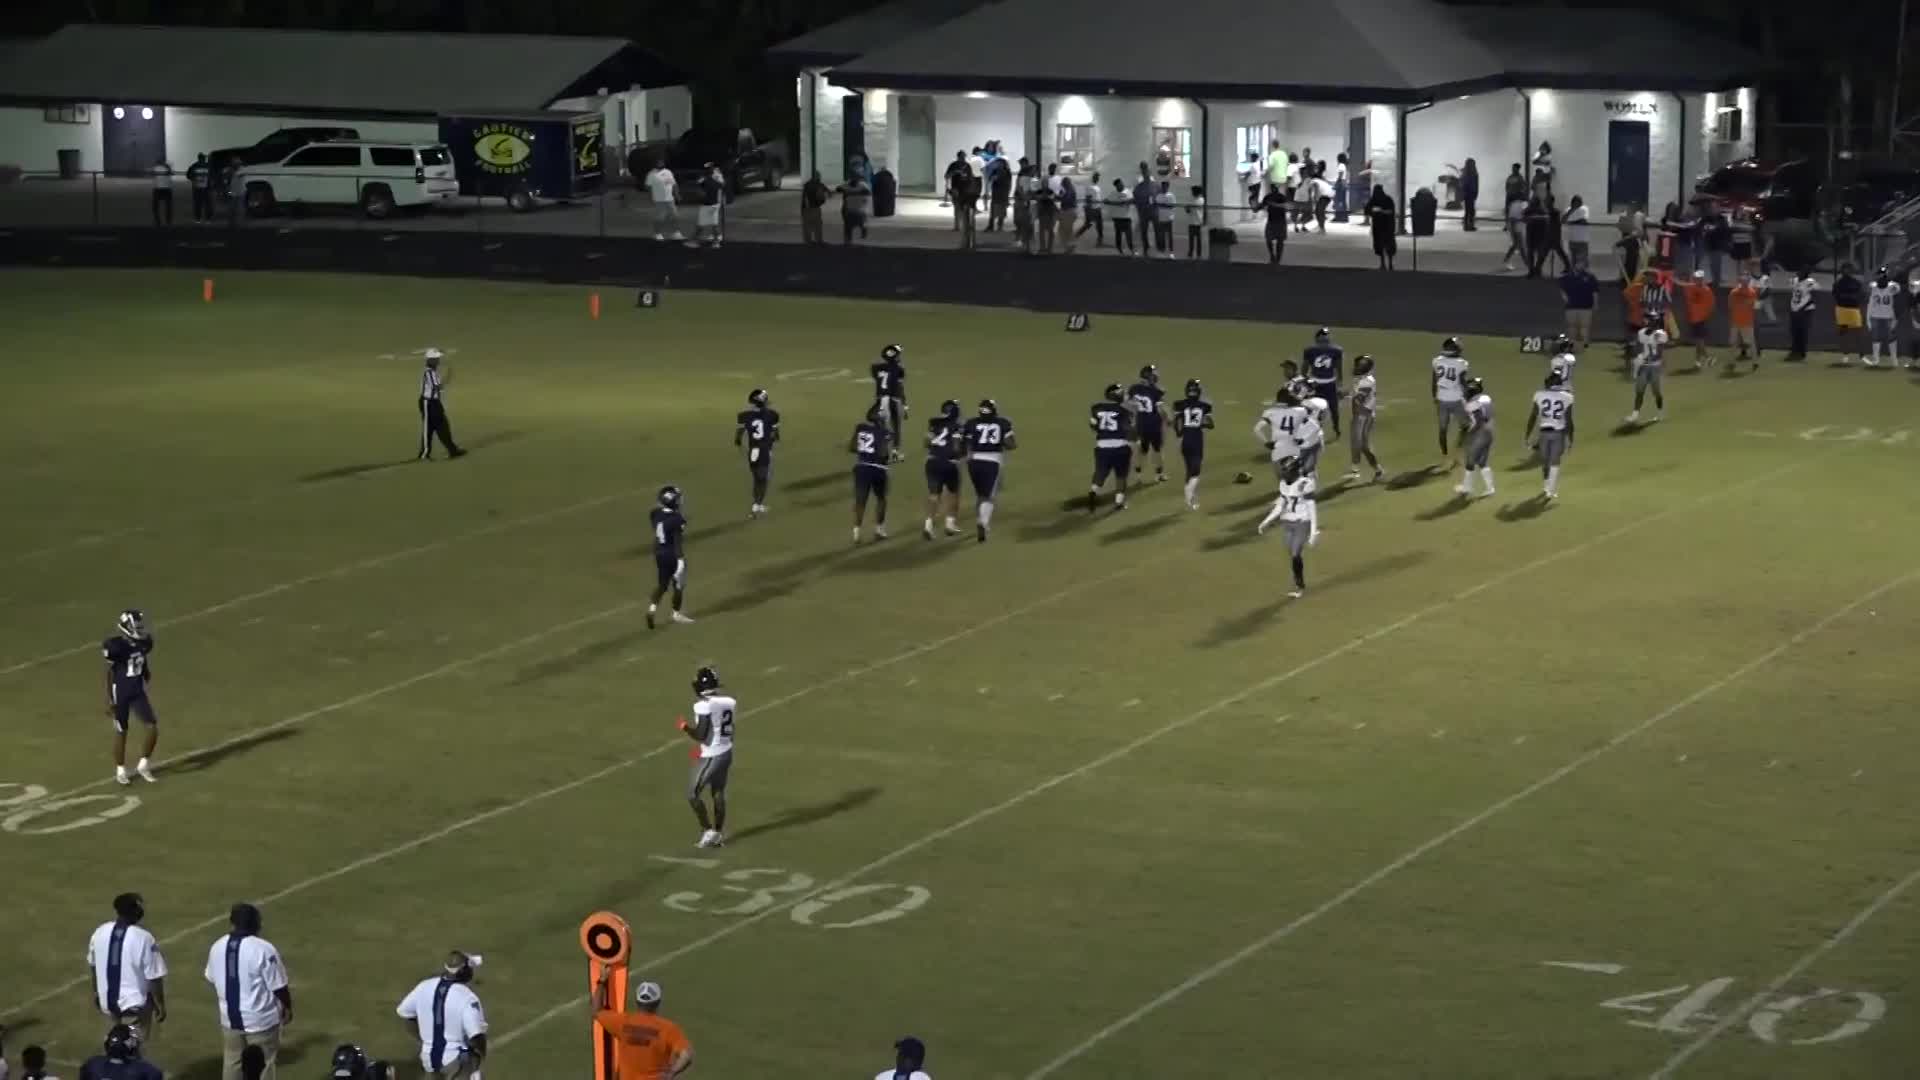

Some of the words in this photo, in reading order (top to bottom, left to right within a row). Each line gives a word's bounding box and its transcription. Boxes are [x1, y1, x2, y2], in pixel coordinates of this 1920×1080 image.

[1523, 337, 1541, 351] 20
[877, 370, 889, 389] 7
[1183, 407, 1203, 428] 13
[1540, 399, 1566, 420] 22
[751, 419, 764, 439] 3
[1097, 410, 1119, 431] 75
[1280, 415, 1294, 435] 4
[976, 423, 1001, 444] 73
[720, 708, 734, 736] 2
[662, 868, 932, 929] 30
[1599, 976, 1888, 1046] 40
